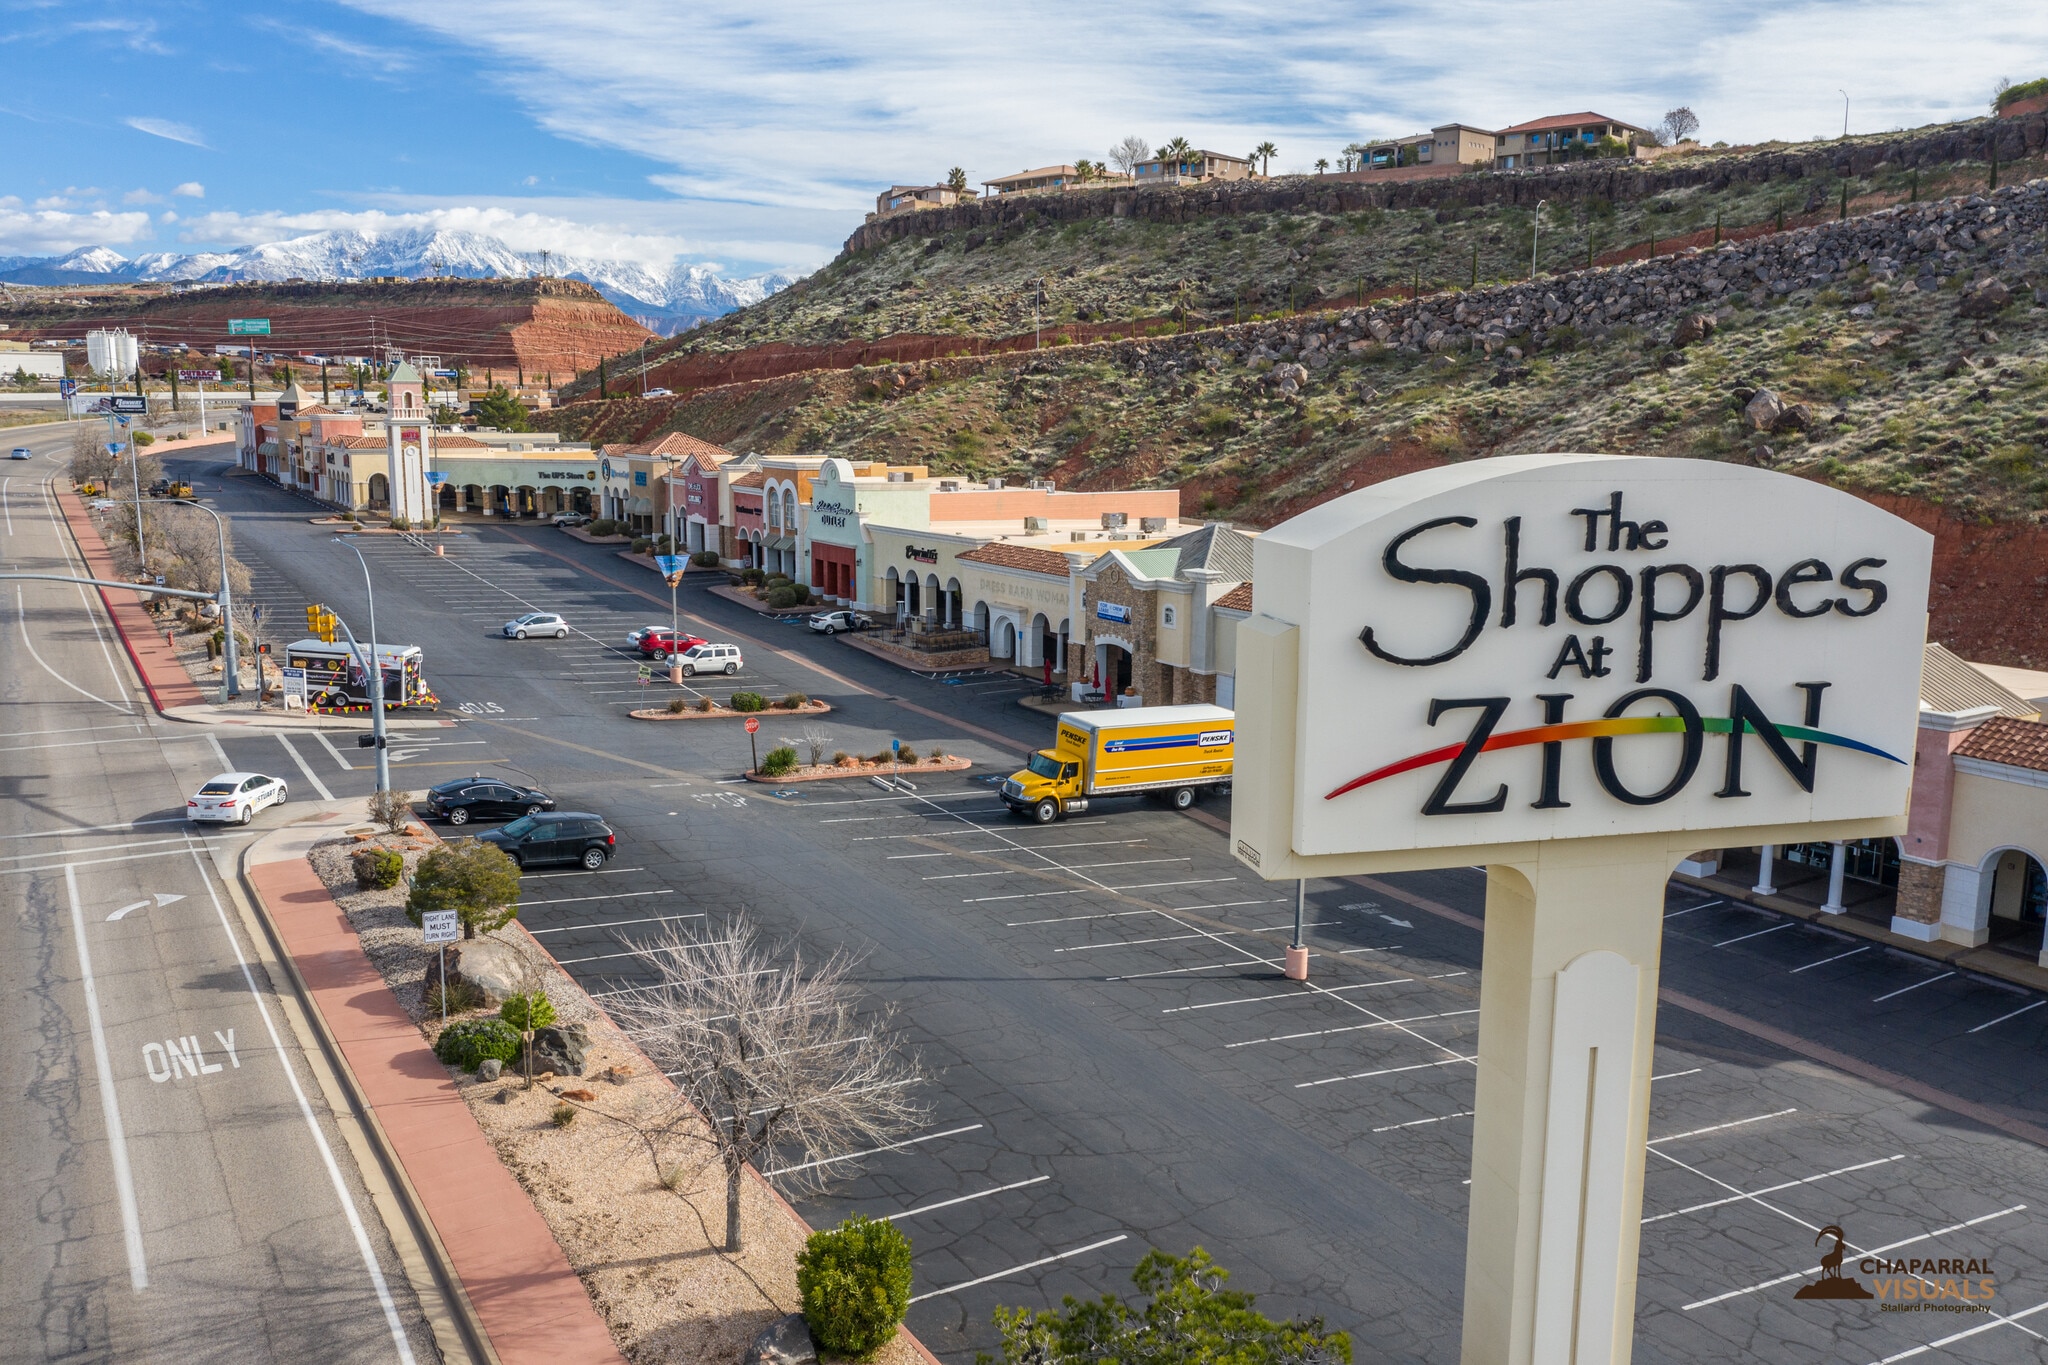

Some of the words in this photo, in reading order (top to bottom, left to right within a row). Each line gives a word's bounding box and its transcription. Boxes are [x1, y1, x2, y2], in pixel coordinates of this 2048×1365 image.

[538, 471, 550, 479] The
[552, 471, 565, 479] UPS
[566, 472, 584, 480] Store
[821, 514, 846, 528] OUTLET
[1570, 490, 1669, 552] The
[980, 579, 1006, 594] DRESS
[1008, 583, 1033, 600] BARN
[1358, 516, 1889, 684] Shoppes
[1546, 634, 1614, 680] At
[459, 701, 505, 714] STOP
[746, 722, 758, 730] STOP
[1060, 729, 1088, 745] PENSKE
[1201, 734, 1229, 743] PENSKE
[1420, 681, 1832, 816] ZION
[256, 788, 276, 803] STUART
[142, 1028, 241, 1083] ONLY
